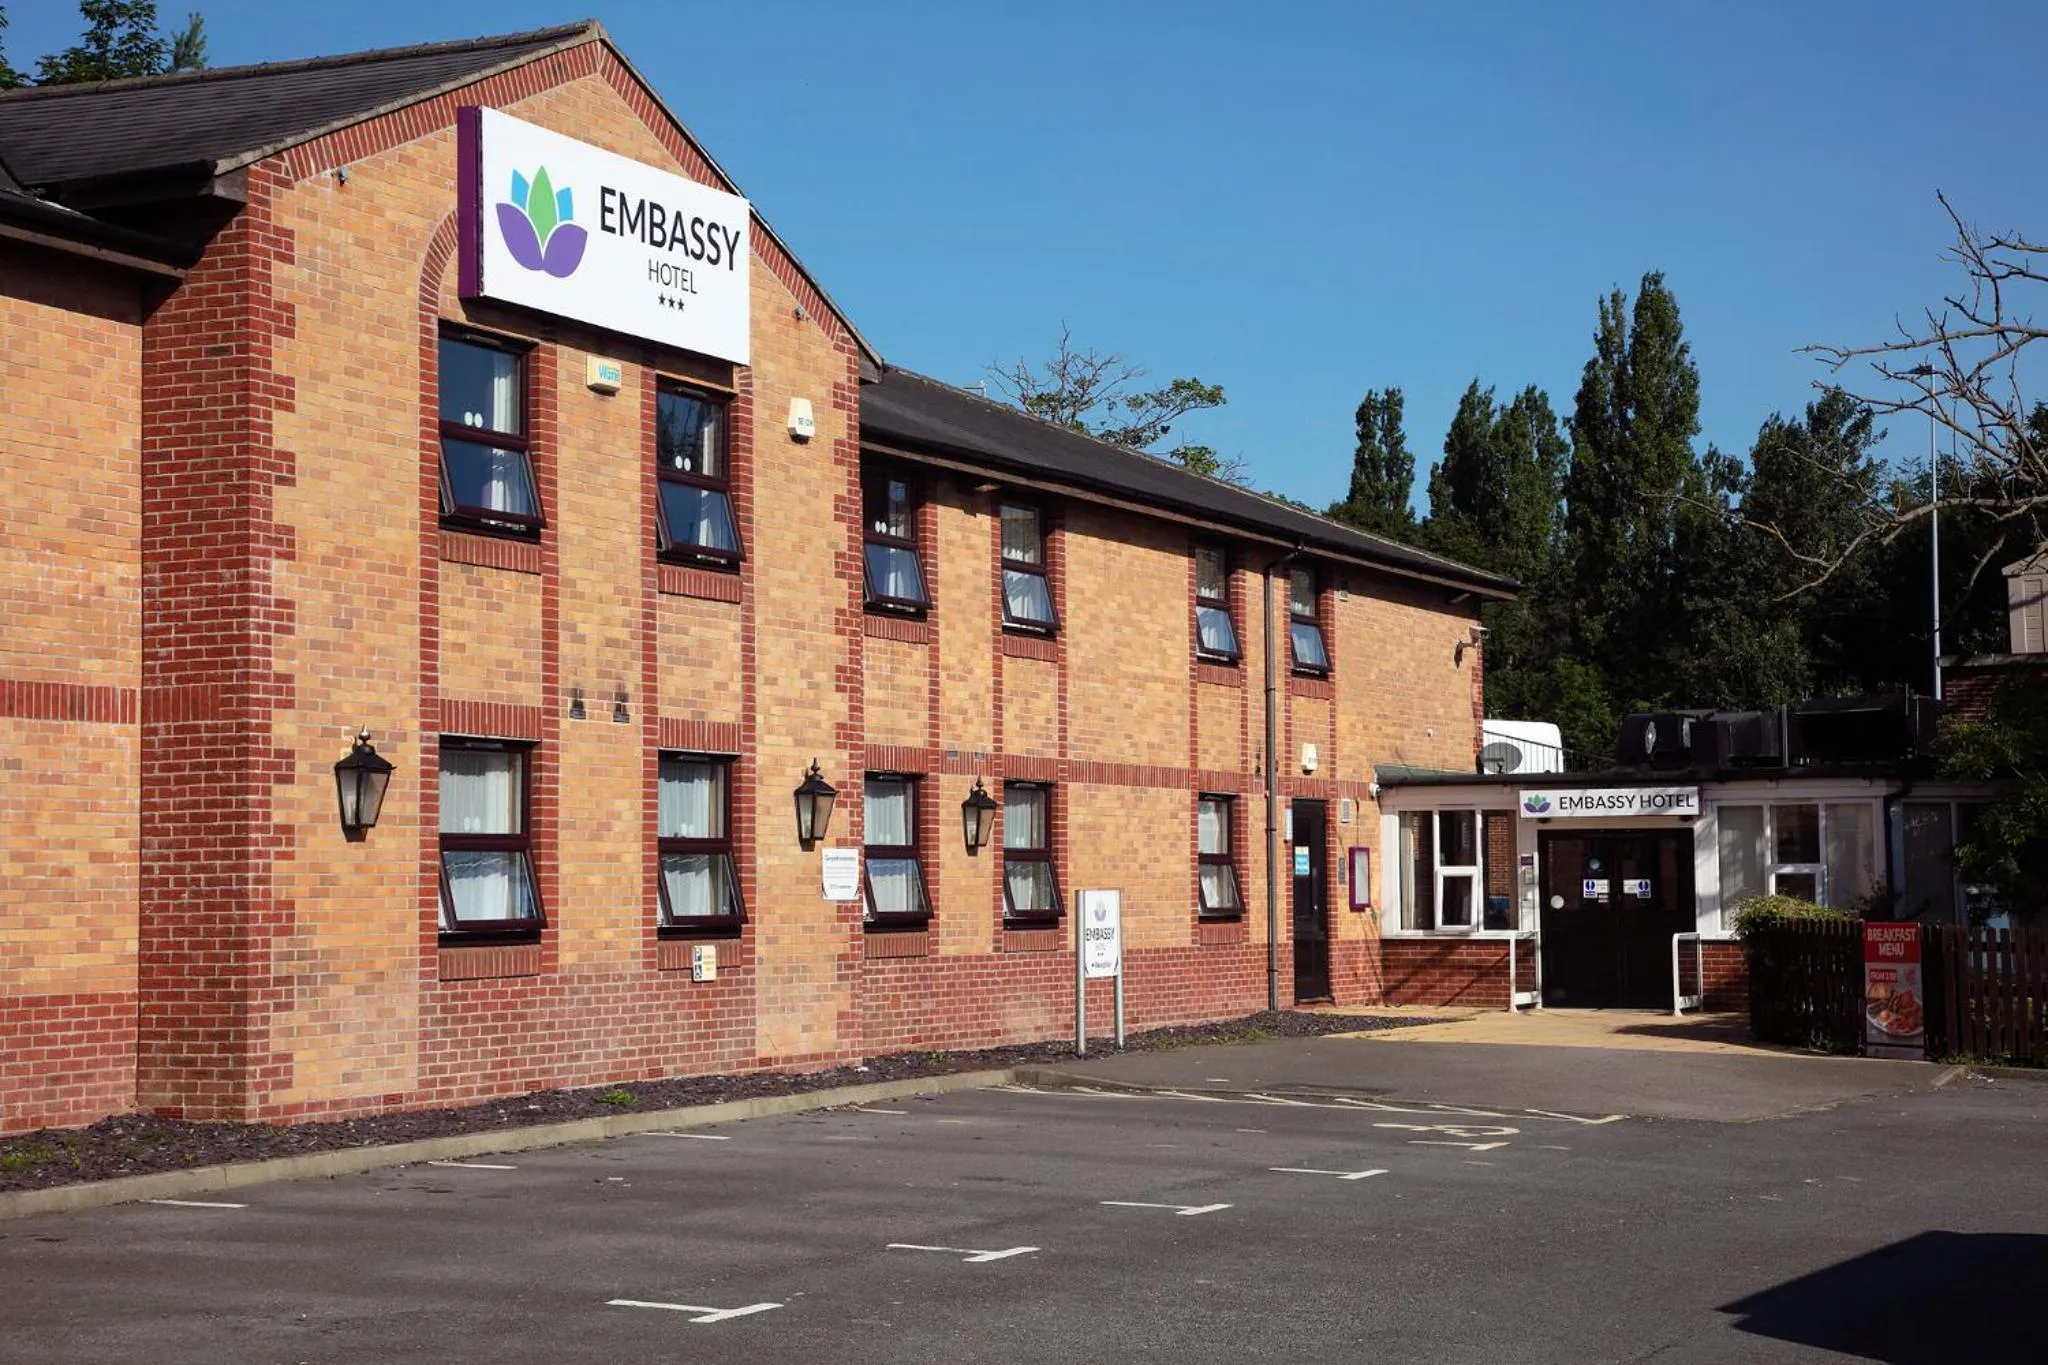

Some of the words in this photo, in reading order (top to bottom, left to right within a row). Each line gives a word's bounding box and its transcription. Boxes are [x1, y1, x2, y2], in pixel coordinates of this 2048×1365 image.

[600, 185, 741, 271] EMBASSY
[648, 259, 698, 295] HOTEL
[1559, 794, 1636, 810] EMBASSY
[1640, 793, 1695, 809] HOTEL
[1085, 927, 1115, 941] EMBASSY
[1867, 927, 1917, 942] BREAKFAST
[1878, 942, 1905, 957] MENU
